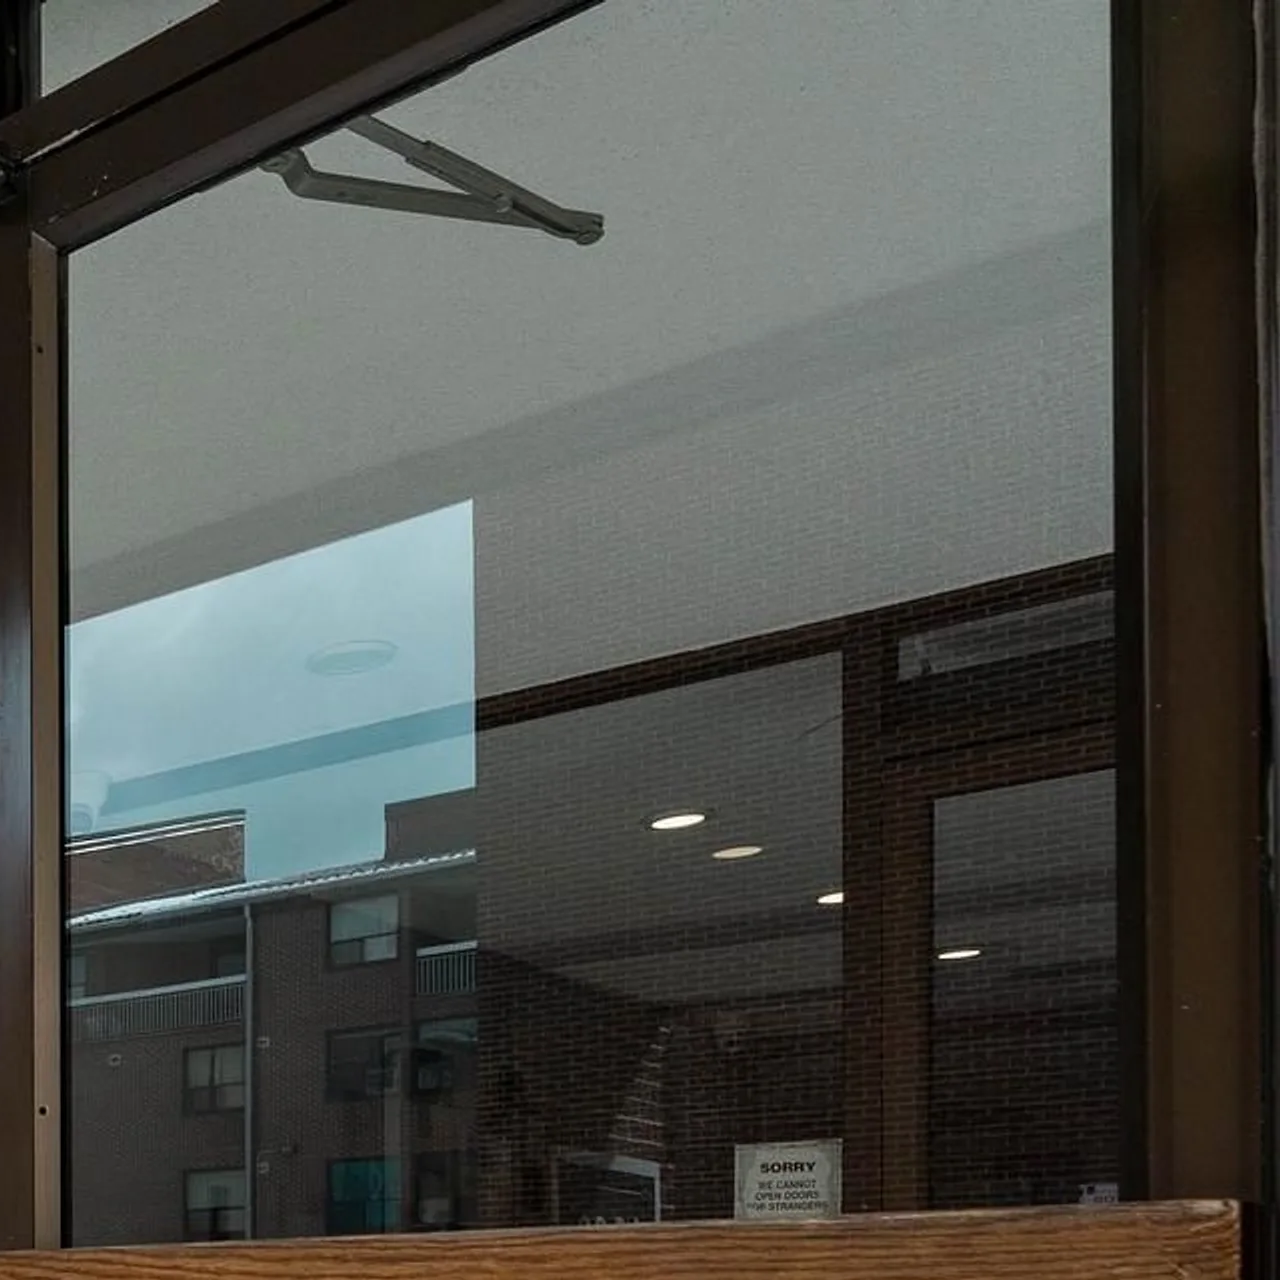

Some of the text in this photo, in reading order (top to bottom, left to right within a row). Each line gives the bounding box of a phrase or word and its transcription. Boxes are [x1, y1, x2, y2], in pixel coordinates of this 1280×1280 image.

[760, 1161, 816, 1173] SORRY
[776, 1179, 816, 1189] CANNOT
[755, 1190, 819, 1202] OPEN DOORS
[767, 1200, 830, 1212] STRANGERS
